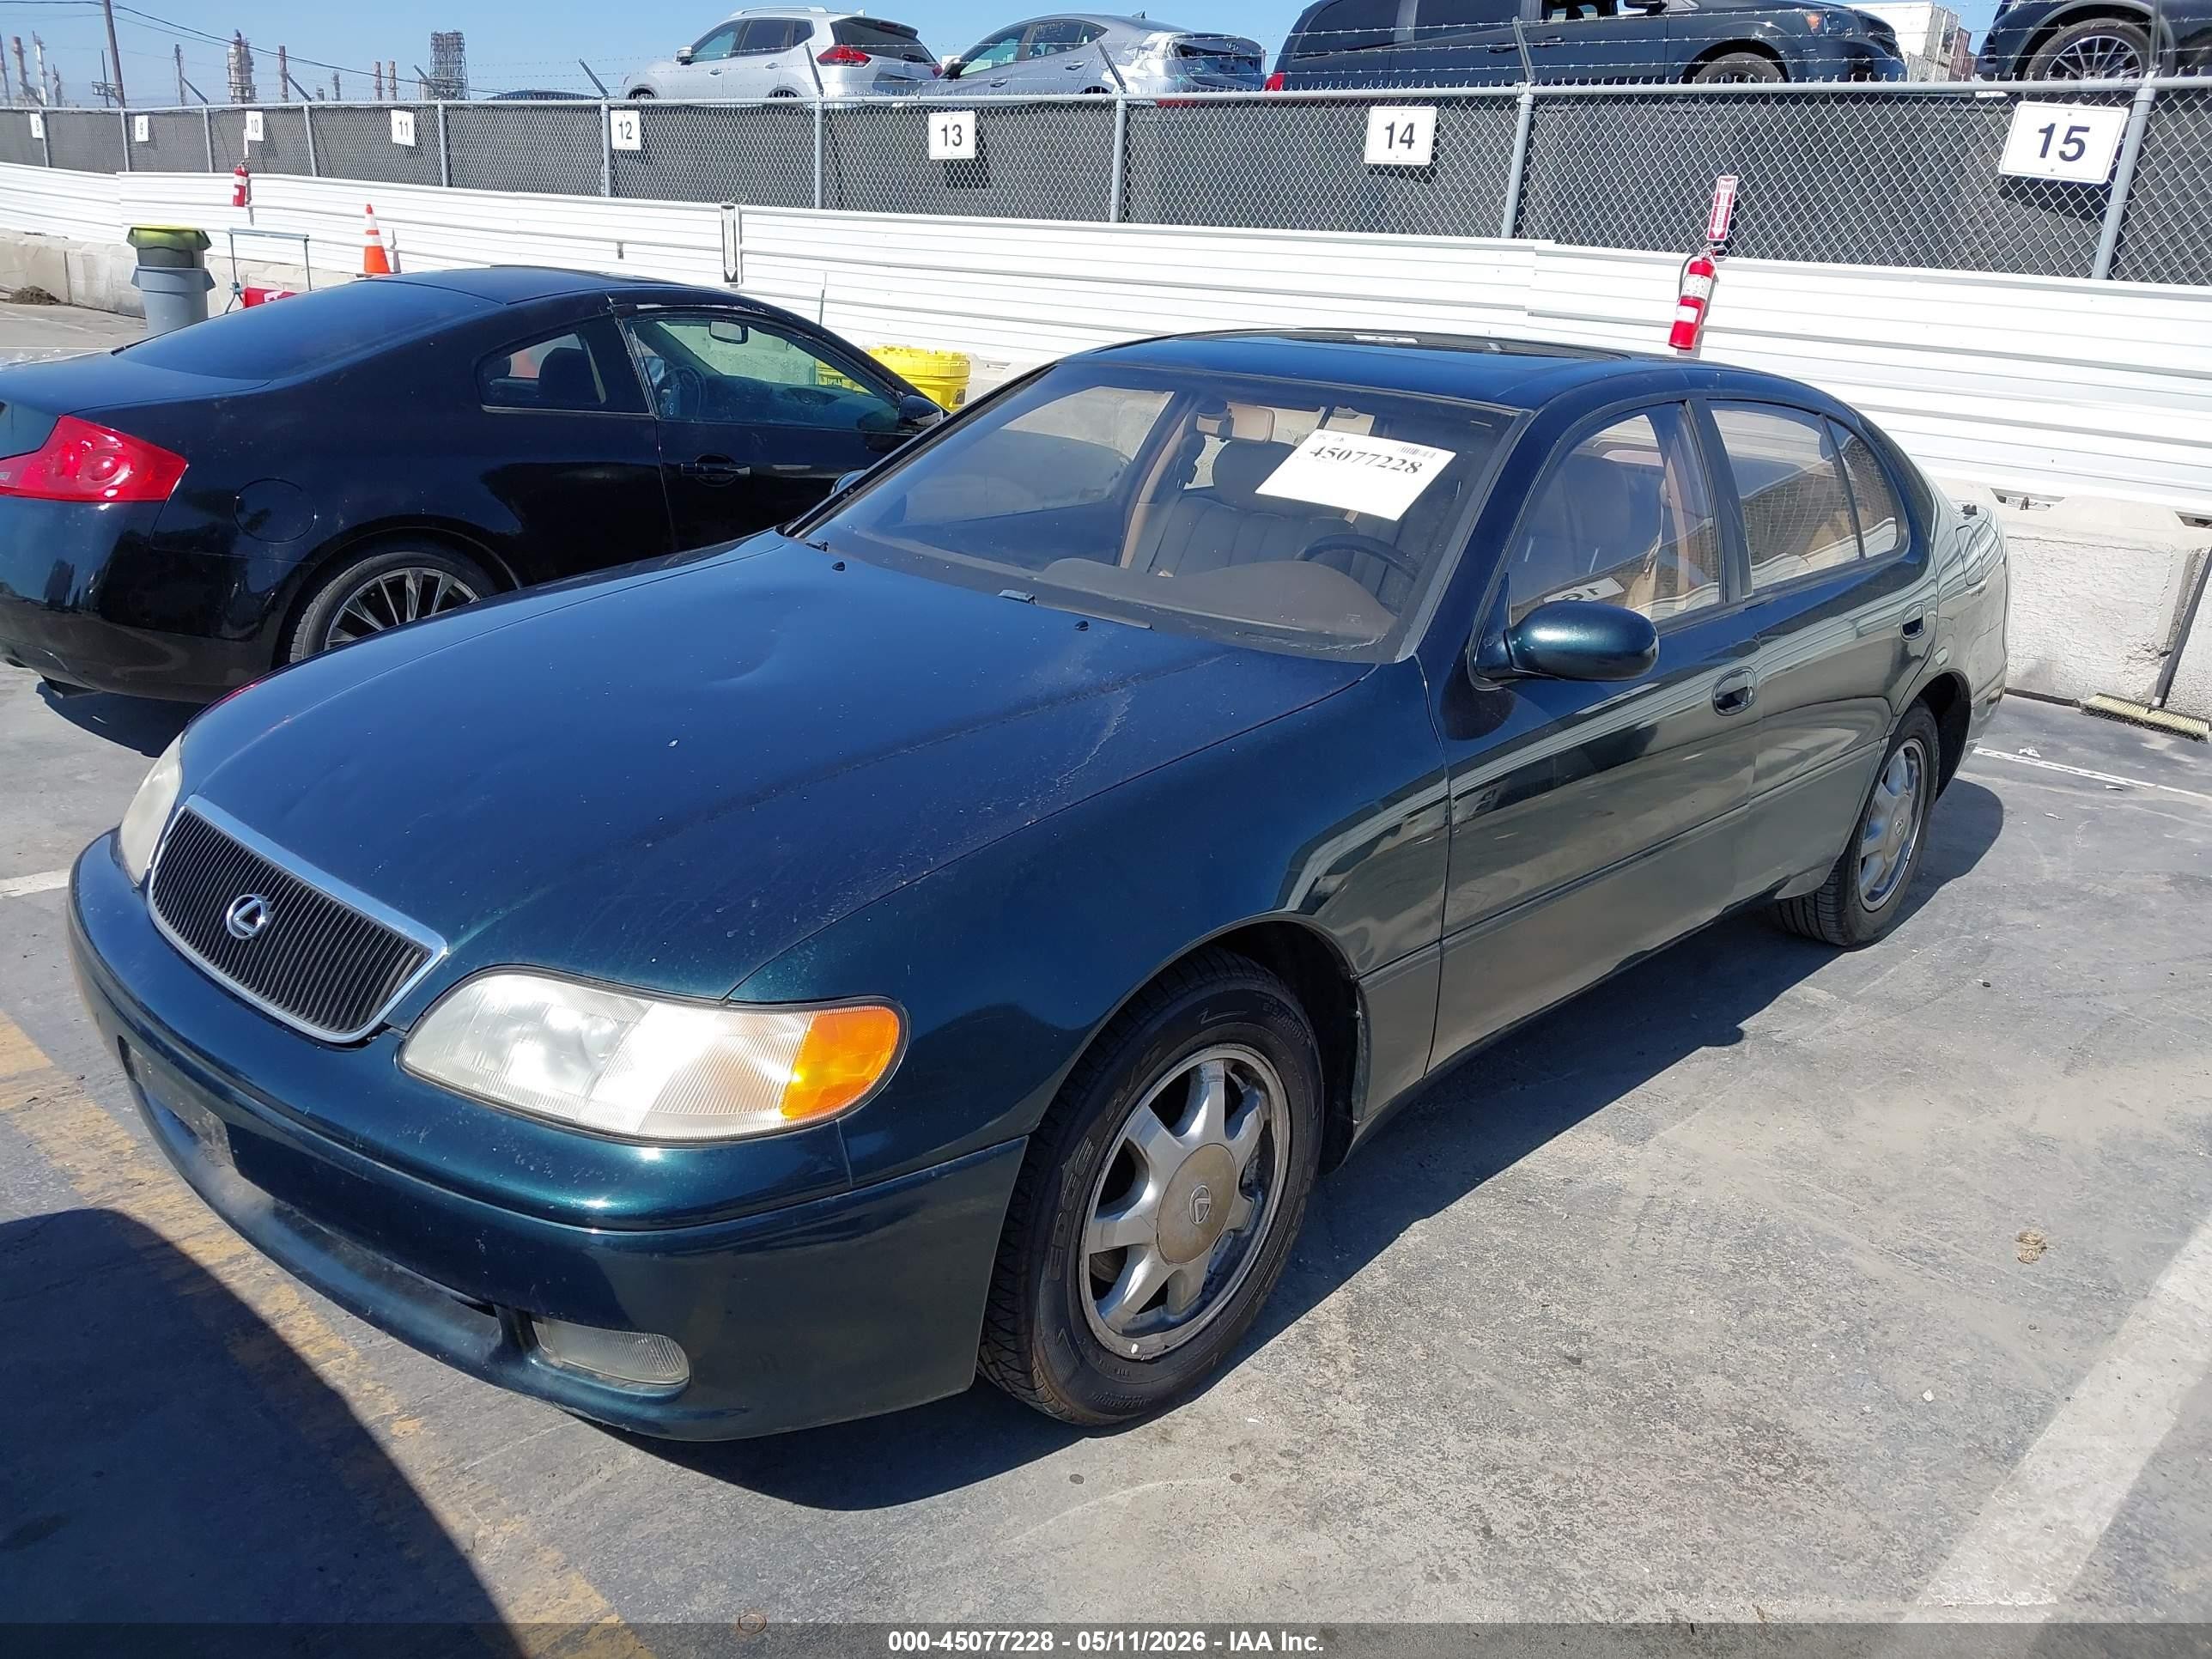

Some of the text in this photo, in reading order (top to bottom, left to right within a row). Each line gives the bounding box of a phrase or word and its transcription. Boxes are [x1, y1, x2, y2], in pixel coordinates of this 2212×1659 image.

[250, 118, 259, 134] 10
[398, 119, 410, 137] 11
[618, 121, 634, 141] 12
[940, 124, 963, 147] 13
[1385, 122, 1415, 149] 14
[2038, 123, 2090, 162] 15
[1309, 445, 1423, 475] 45077228
